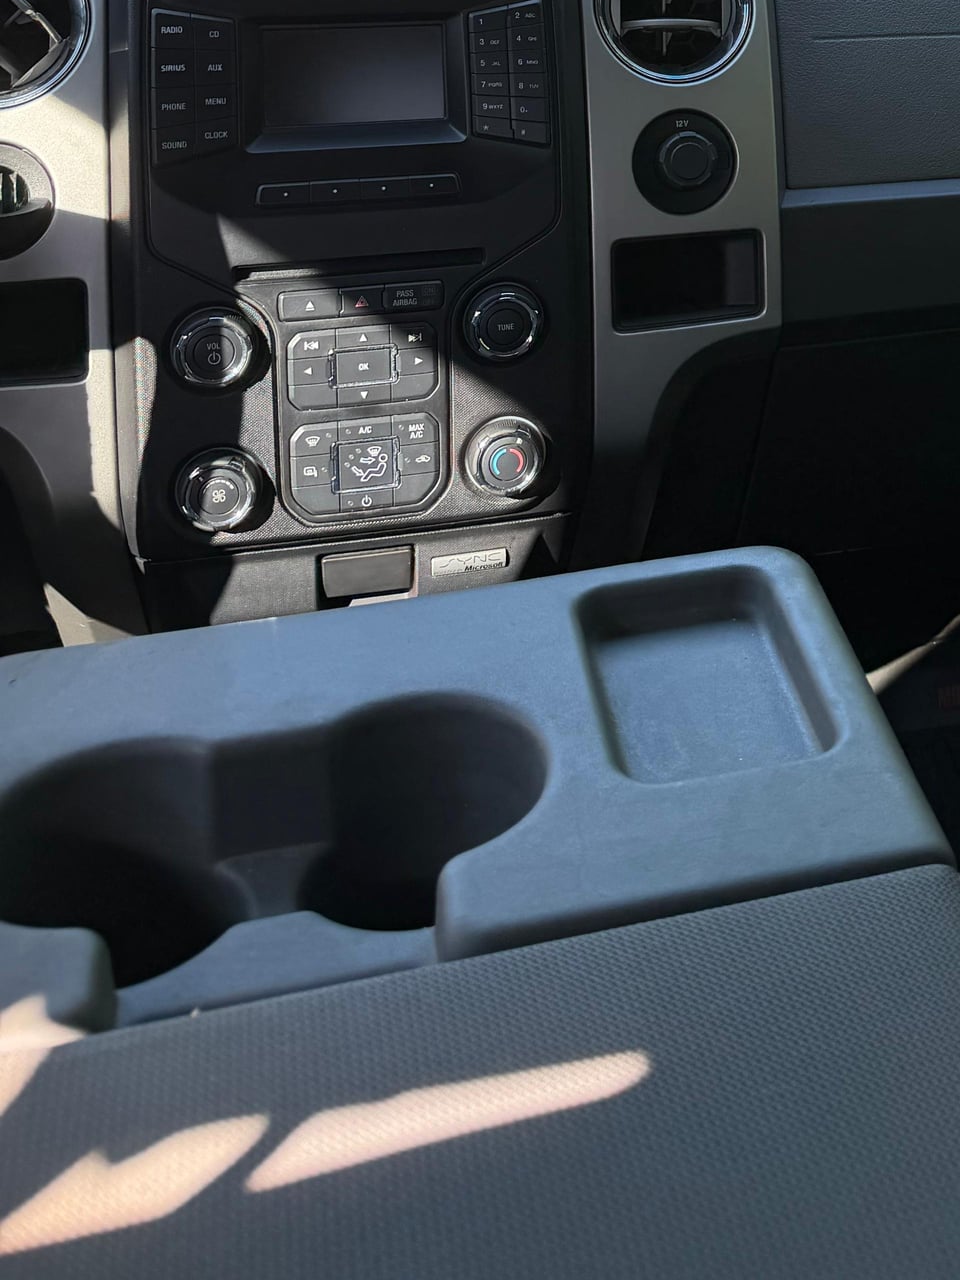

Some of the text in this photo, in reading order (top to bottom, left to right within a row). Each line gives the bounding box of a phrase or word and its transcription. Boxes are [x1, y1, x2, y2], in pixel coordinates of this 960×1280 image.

[514, 11, 521, 19] 2
[160, 26, 183, 34] RADIO
[208, 30, 220, 38] CD
[479, 38, 485, 46] 3
[480, 59, 486, 67] 5
[517, 58, 523, 66] 6
[160, 64, 186, 72] SIRIUS
[205, 97, 227, 106] MENU
[161, 103, 187, 111] PHONE
[675, 119, 689, 128] 12V
[204, 131, 228, 140] CLOCK
[162, 141, 187, 150] SOUND
[396, 290, 414, 298] PASS
[392, 297, 418, 306] AIRBAG
[497, 323, 515, 331] TUNE
[206, 342, 221, 350] VOL
[358, 363, 369, 371] OK
[358, 426, 372, 435] A/C
[408, 423, 425, 432] MAX
[410, 431, 424, 439] A/C
[439, 552, 501, 568] SYNC
[464, 562, 504, 572] Microsoft
